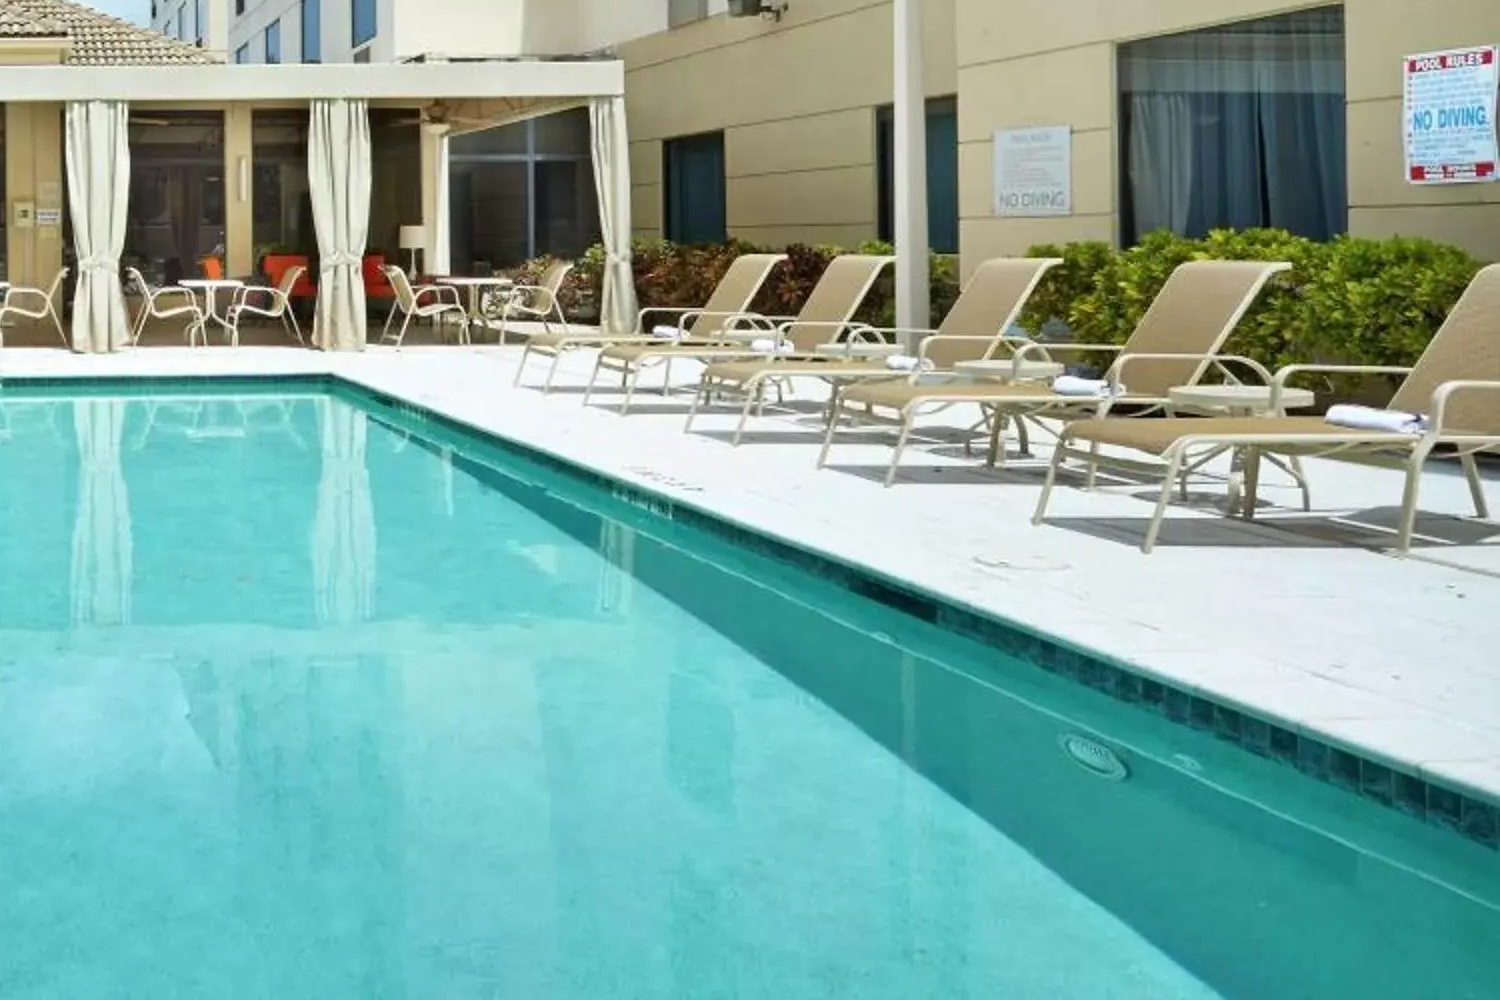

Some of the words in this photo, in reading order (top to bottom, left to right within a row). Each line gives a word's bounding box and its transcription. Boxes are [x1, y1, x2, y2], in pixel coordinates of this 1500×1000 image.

[1415, 57, 1442, 71] POOL
[1446, 52, 1483, 68] RULES
[1413, 109, 1433, 130] NO
[1437, 105, 1486, 129] DIVING
[999, 192, 1019, 208] NO
[1021, 190, 1064, 207] DIVING
